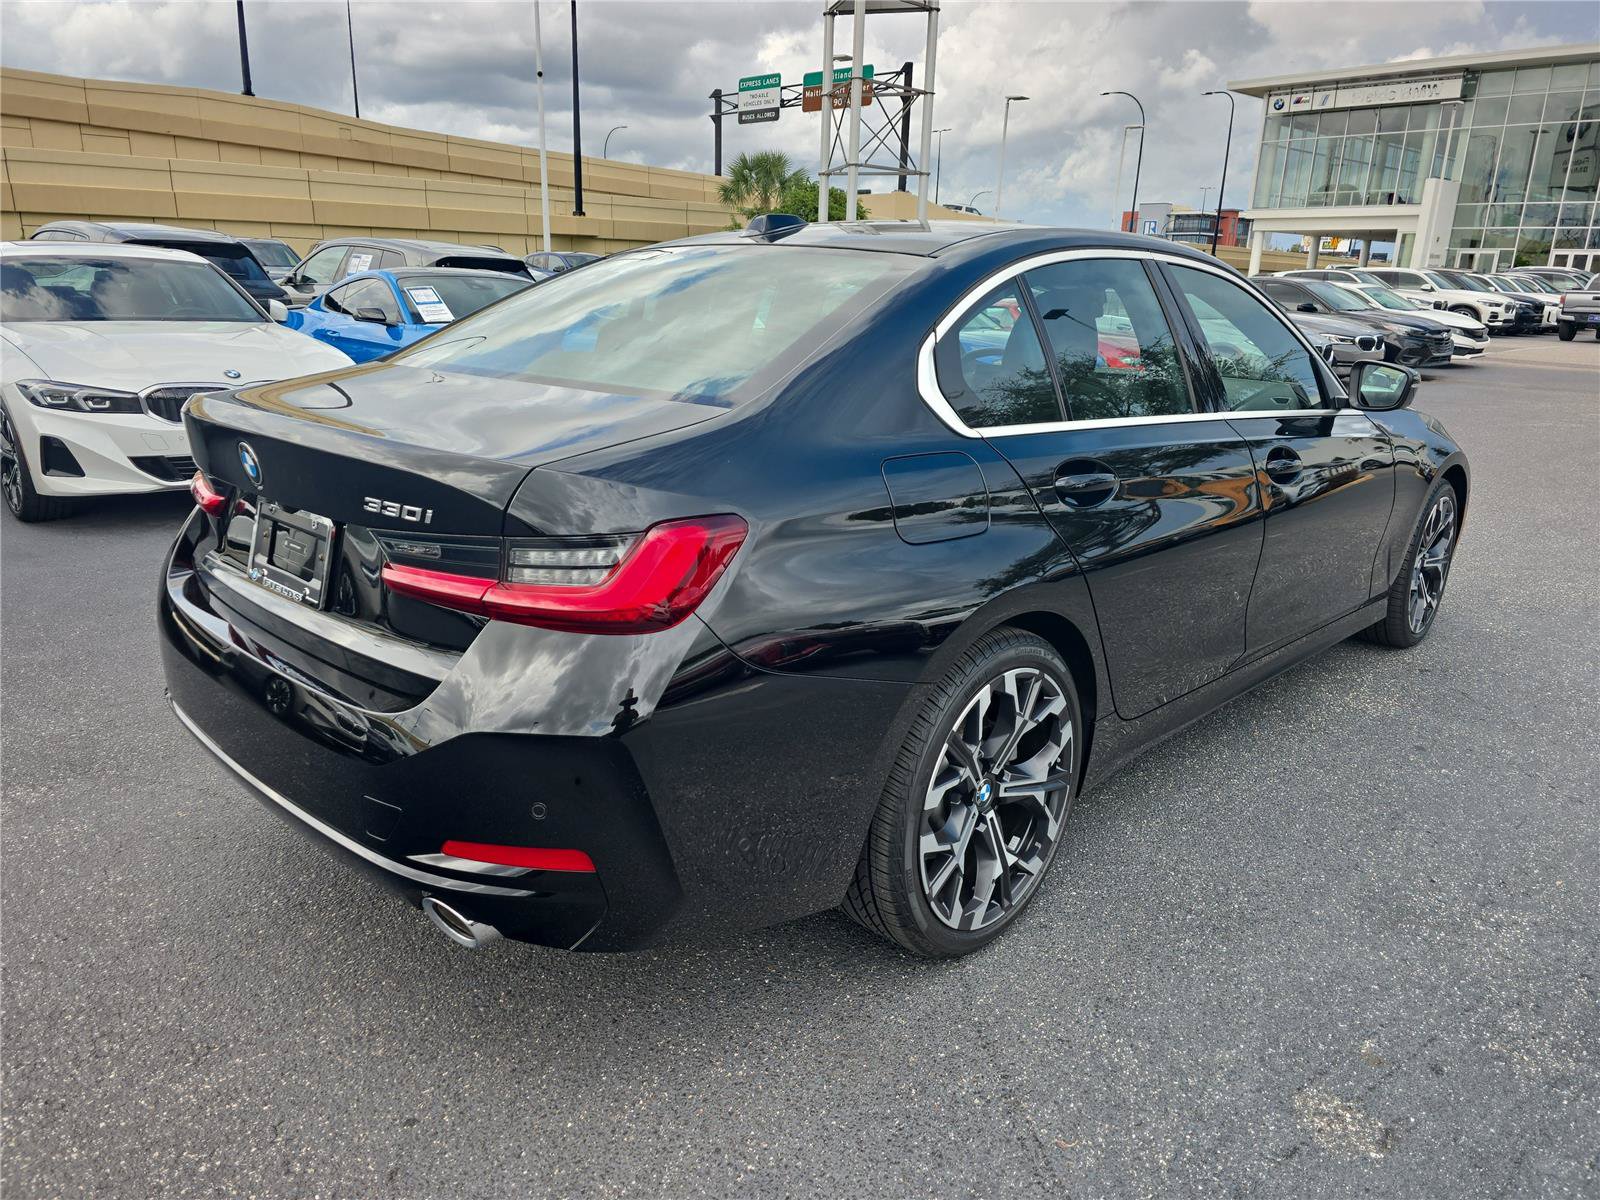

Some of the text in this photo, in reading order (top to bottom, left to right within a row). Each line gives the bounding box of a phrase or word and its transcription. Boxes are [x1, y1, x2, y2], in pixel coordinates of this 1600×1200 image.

[740, 77, 779, 88] EXPRESS LANES
[363, 496, 434, 524] 330i
[263, 577, 304, 602] FIELDS
